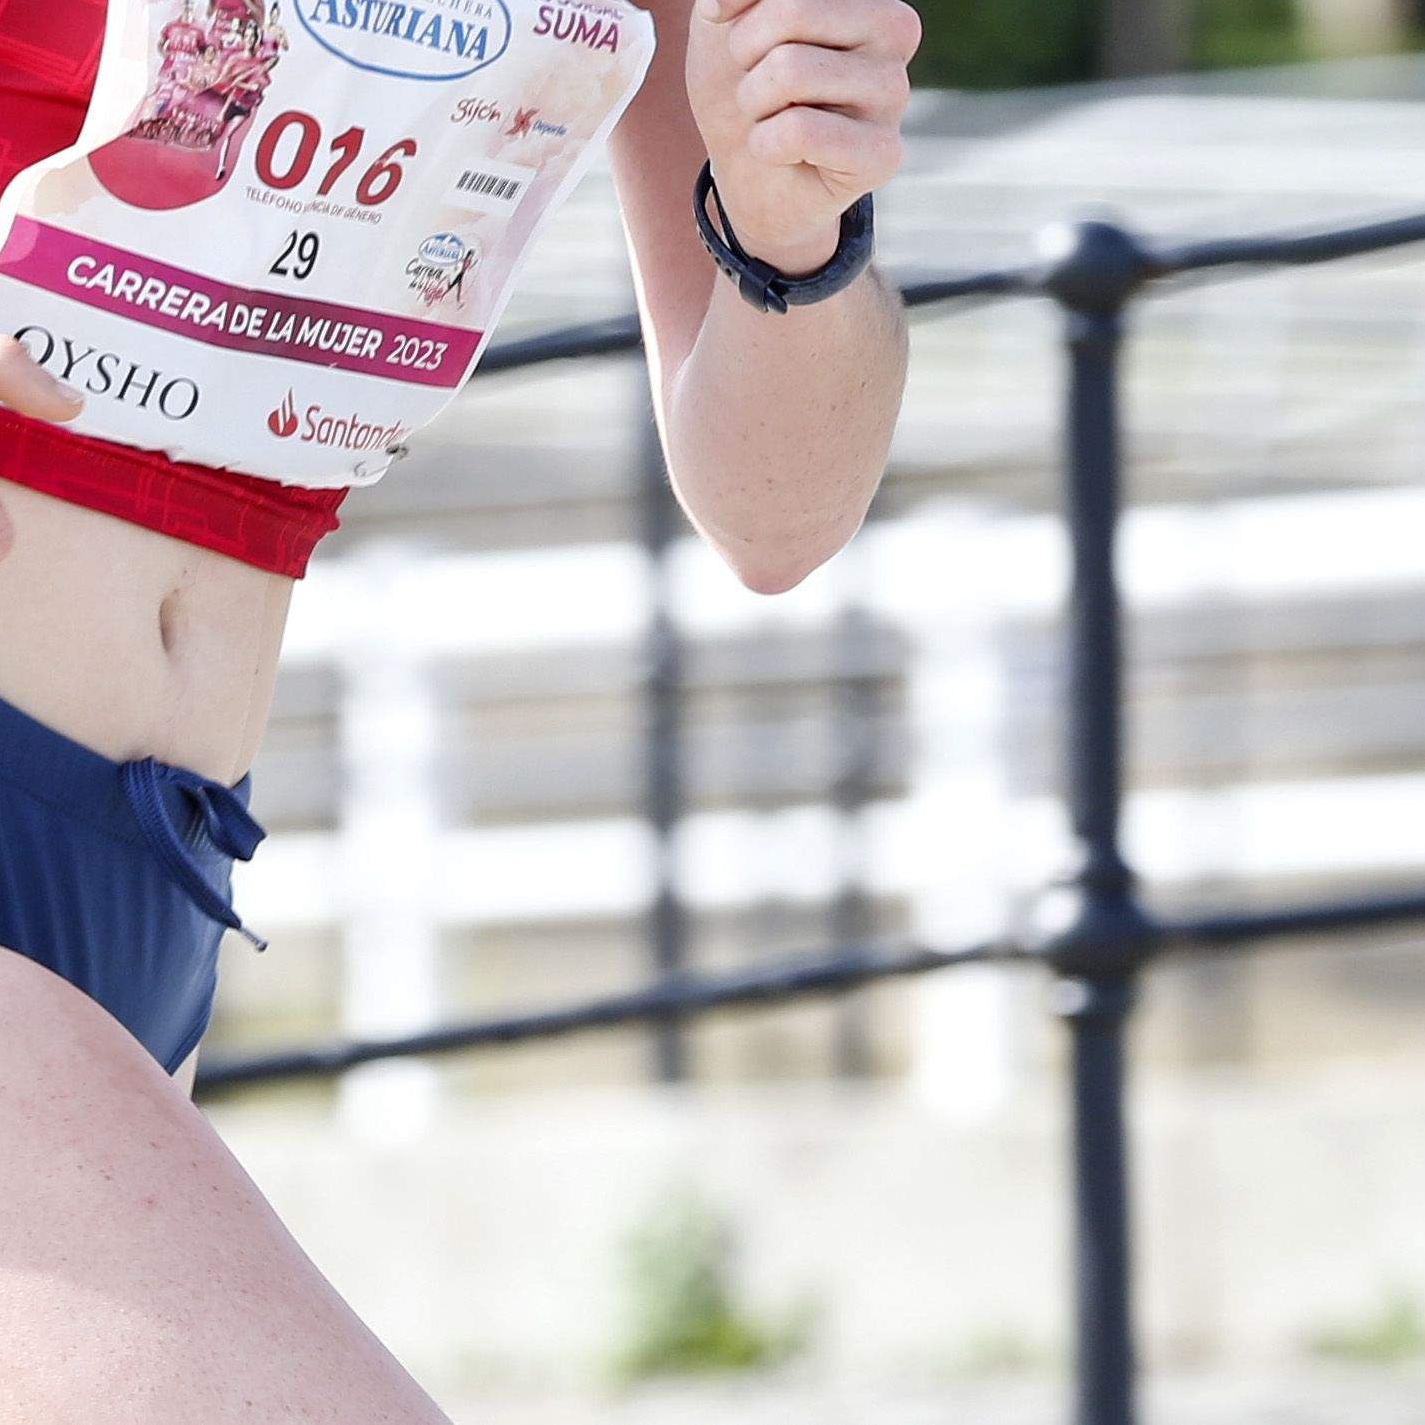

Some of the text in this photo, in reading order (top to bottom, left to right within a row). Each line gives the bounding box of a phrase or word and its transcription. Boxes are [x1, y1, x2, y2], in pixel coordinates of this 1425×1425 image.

[533, 5, 618, 53] SUMA
[255, 110, 417, 206] 016
[245, 185, 303, 214] TELÉFONO
[269, 229, 319, 280] 29
[67, 255, 449, 371] CARRERA DE LA MUJER 2023
